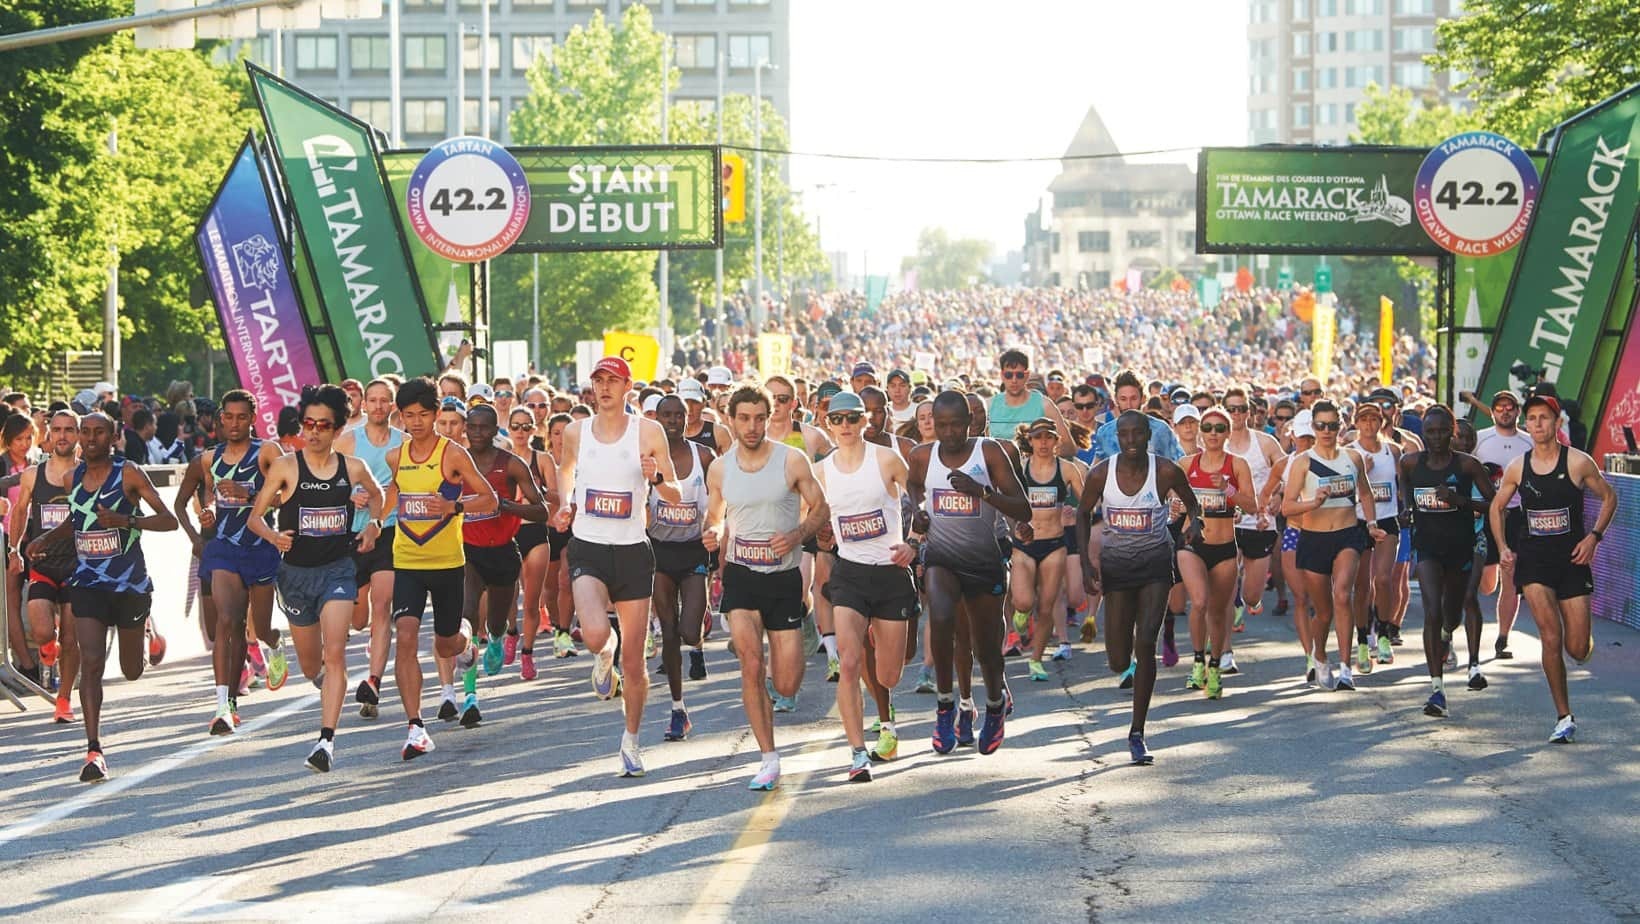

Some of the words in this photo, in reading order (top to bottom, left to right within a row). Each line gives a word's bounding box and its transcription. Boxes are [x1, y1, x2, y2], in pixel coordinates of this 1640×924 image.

[441, 140, 493, 156] TARTAN
[1440, 135, 1516, 157] TAMARACK
[567, 163, 674, 194] START
[1231, 174, 1241, 182] DE
[1242, 174, 1275, 183] SEMAINE
[1277, 175, 1289, 183] DES
[1293, 175, 1325, 183] COURSES
[1326, 176, 1365, 184] D'OTTAWA
[429, 187, 507, 217] 42.2
[1216, 182, 1365, 209] TAMARACK
[1435, 180, 1519, 211] 42.2
[411, 187, 427, 233] OTTAWA
[502, 185, 527, 242] MARATHON
[549, 194, 675, 233] DÉBUT
[1216, 210, 1262, 220] OTTAWA
[1264, 210, 1291, 220] RACE
[1294, 211, 1347, 221] WEEKEND
[1418, 198, 1452, 245] OTTAWA
[1455, 241, 1489, 254] RACE
[1493, 199, 1535, 249] WEEKEND
[1529, 135, 1632, 350] TAMARACK
[322, 187, 405, 382] TAMARAC
[250, 288, 302, 409] TARTA
[620, 345, 636, 363] C
[233, 315, 269, 408] INTERNATIONAL
[300, 481, 331, 491] GMO
[594, 497, 622, 513] KENT
[938, 495, 973, 510] KOECH
[302, 513, 345, 529] SHIMODA
[840, 516, 884, 536] PREISNER
[1110, 514, 1148, 528] LANGAT
[77, 535, 118, 552] SHIFERAW
[735, 543, 780, 560] WOODFIN
